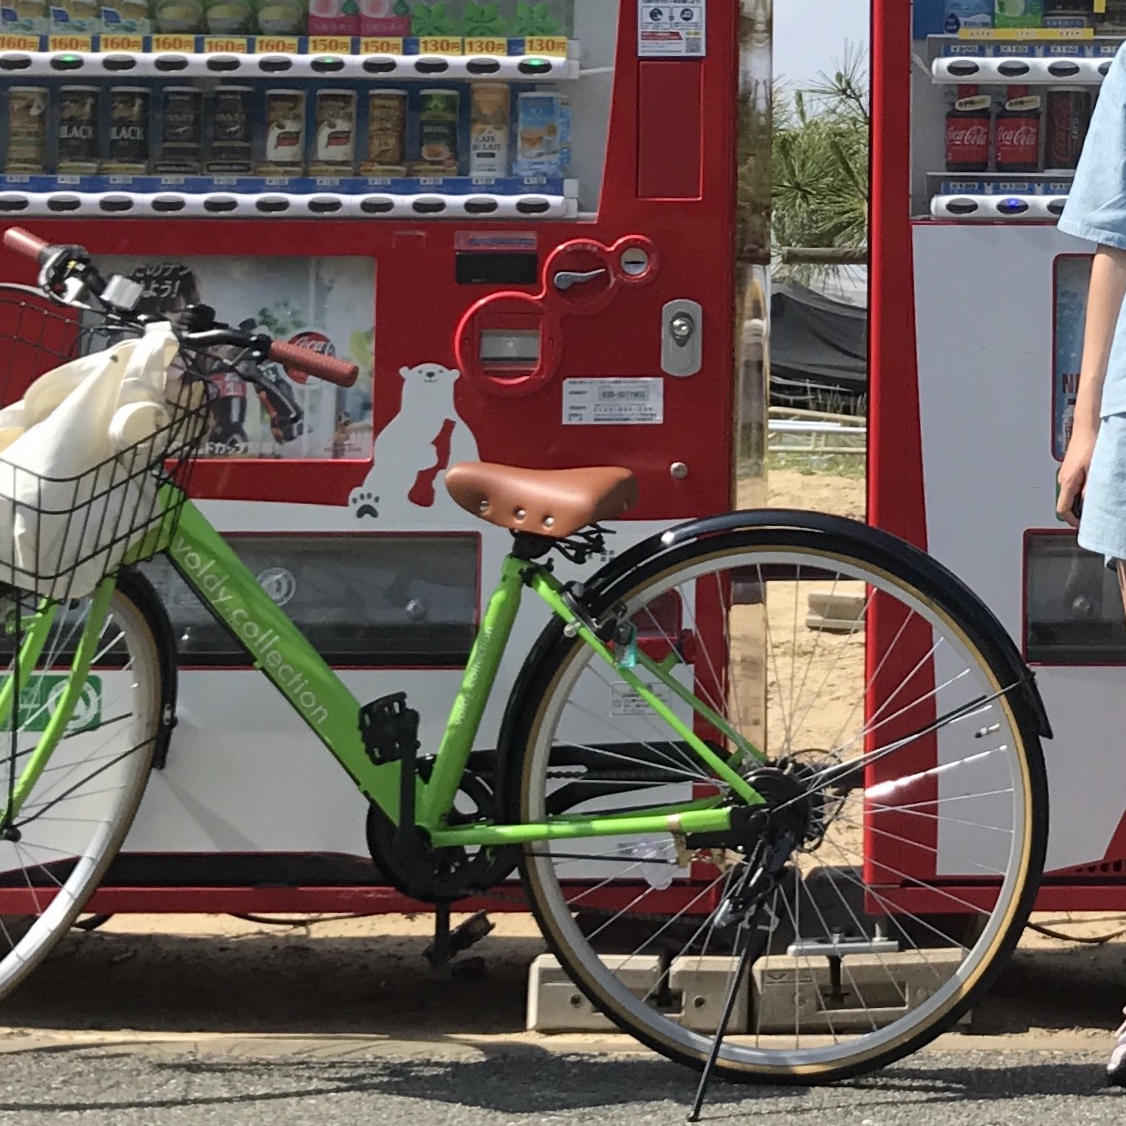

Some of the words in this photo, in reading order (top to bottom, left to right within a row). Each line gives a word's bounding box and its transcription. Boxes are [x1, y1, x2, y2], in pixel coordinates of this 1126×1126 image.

[51, 36, 90, 50] 160円
[102, 36, 142, 50] 160円
[154, 36, 194, 50] 160円
[206, 39, 245, 52] 160円
[258, 38, 297, 52] 160円
[311, 37, 350, 52] 150円
[364, 39, 401, 52] 150円
[422, 37, 461, 52] 130円
[467, 39, 506, 53] 130円
[527, 37, 566, 52] 130円
[177, 535, 329, 725] voldy.collection
